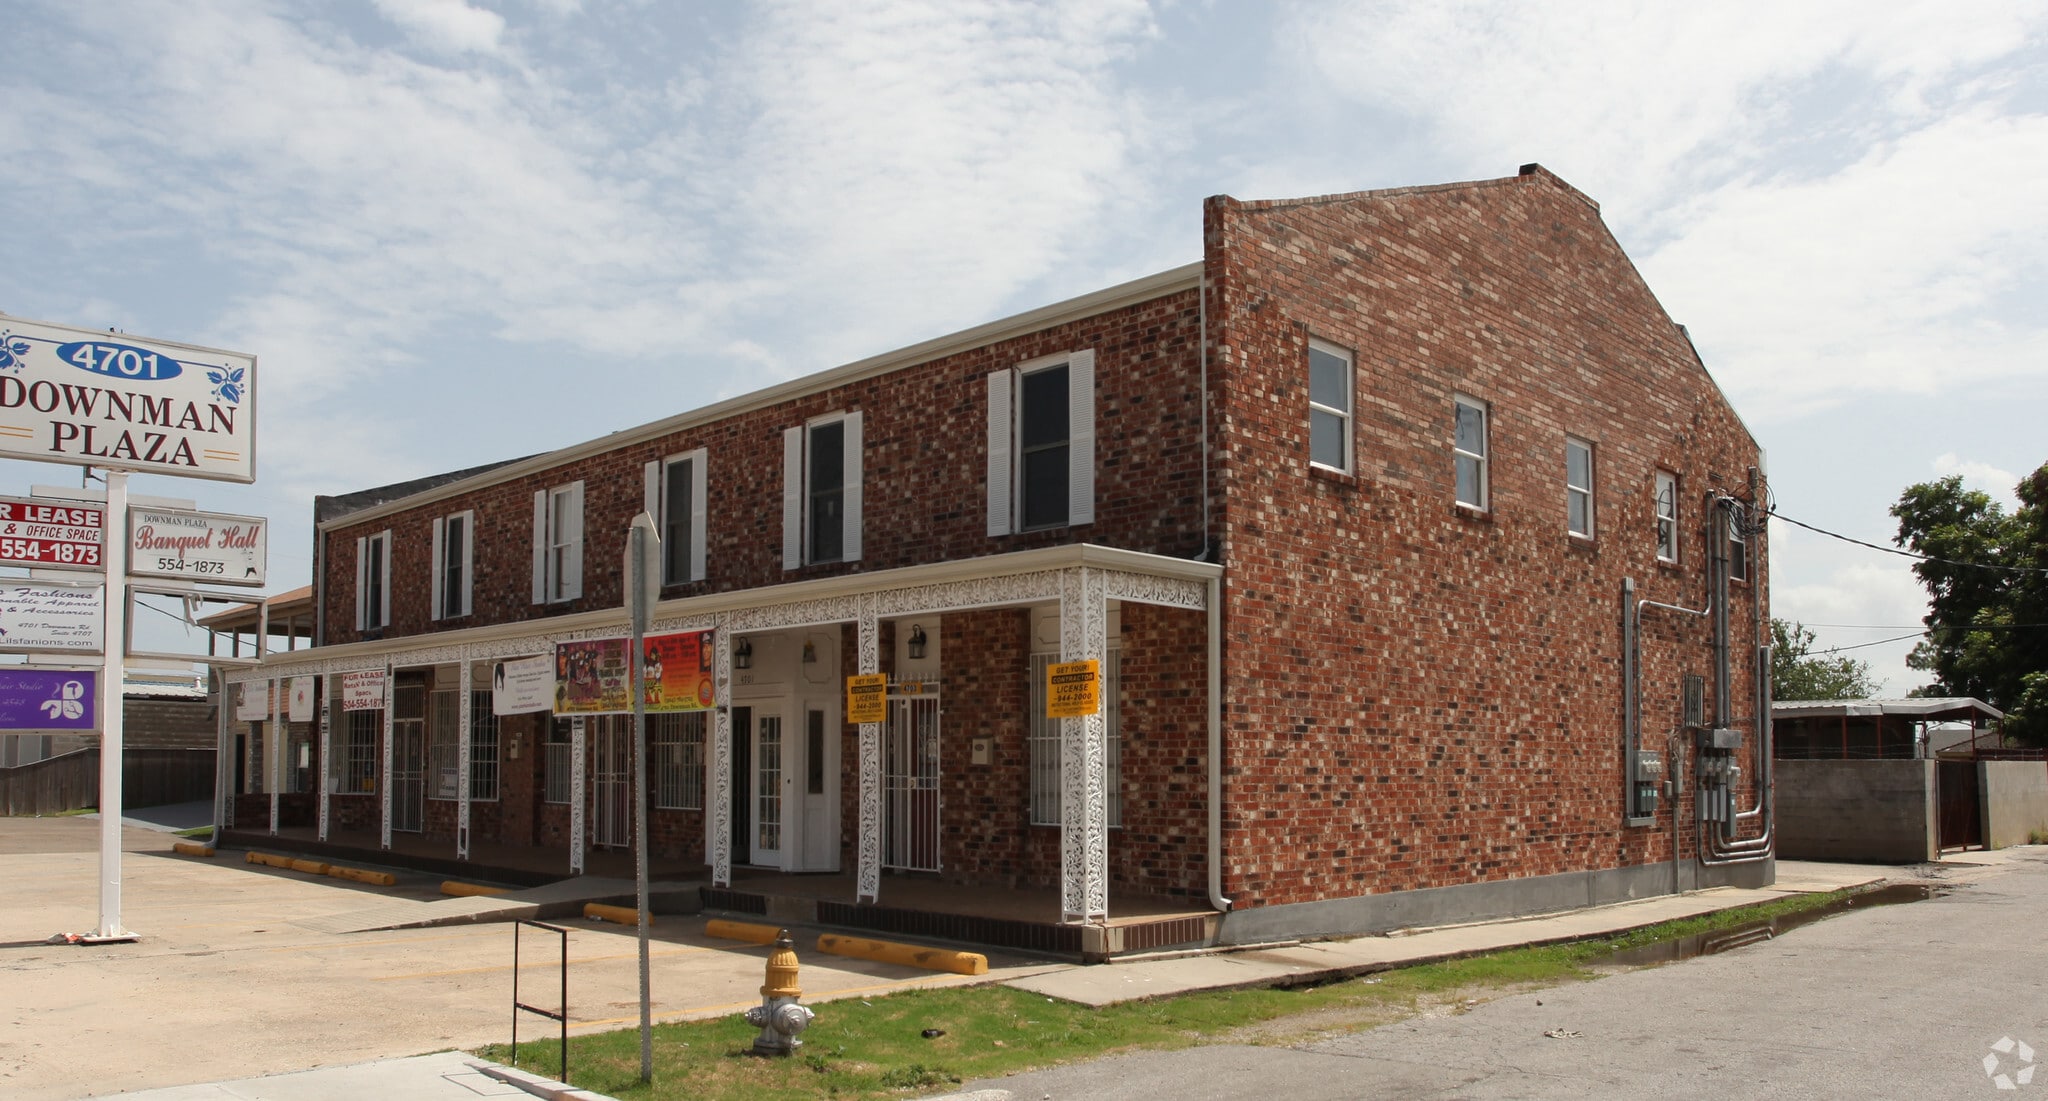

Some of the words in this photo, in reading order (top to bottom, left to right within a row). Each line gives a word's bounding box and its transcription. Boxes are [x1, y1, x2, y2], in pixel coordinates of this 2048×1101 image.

[71, 344, 158, 378] 4701
[0, 375, 237, 435] DOWNMAN
[49, 420, 199, 467] PLAZA
[25, 506, 99, 527] LEASE
[144, 514, 182, 526] DOWNMAN
[184, 519, 208, 528] PLAZA
[4, 523, 17, 534] &
[26, 525, 62, 538] OFFICE
[66, 528, 99, 541] SPACE
[134, 525, 213, 558] Banquet
[218, 525, 259, 549] Hall
[1, 539, 99, 564] 554-1873
[158, 557, 225, 574] 554-1873
[15, 587, 94, 599] Fashions
[22, 607, 94, 616] Accessories
[45, 599, 100, 607] Apparel
[360, 671, 385, 679] LEASE
[1052, 674, 1094, 683] CONTRACTOR
[1056, 683, 1089, 694] LICENSE
